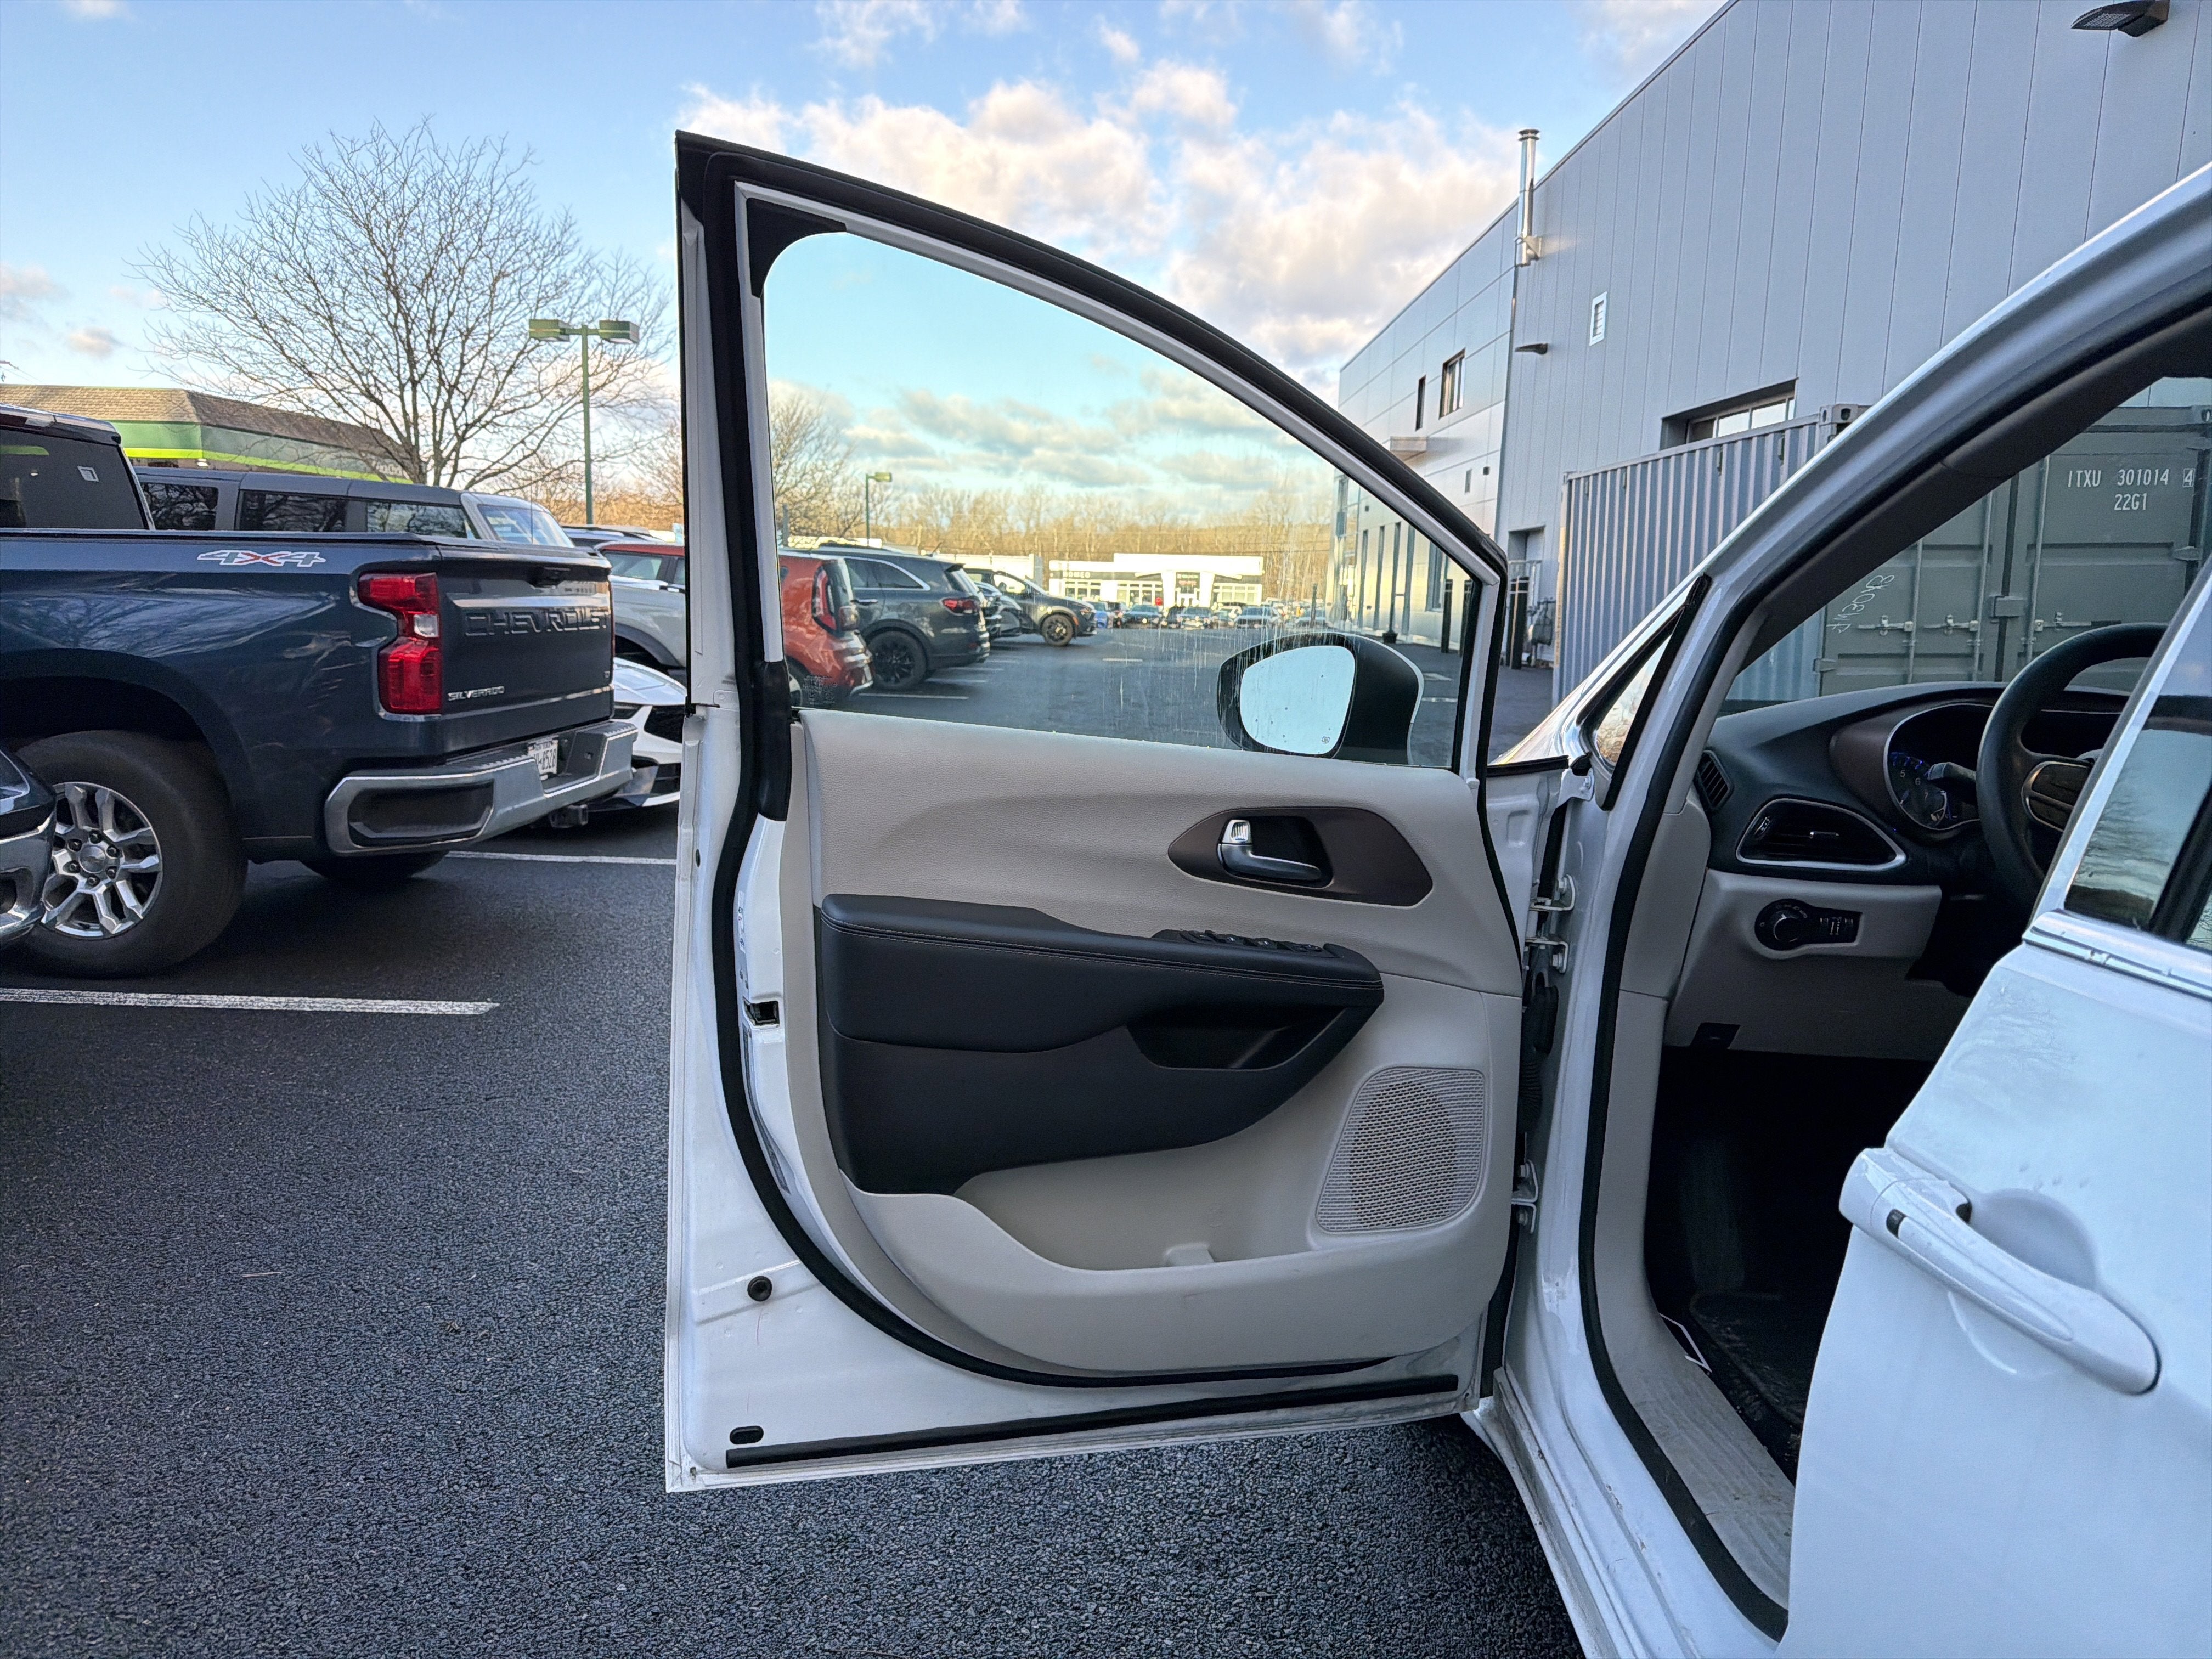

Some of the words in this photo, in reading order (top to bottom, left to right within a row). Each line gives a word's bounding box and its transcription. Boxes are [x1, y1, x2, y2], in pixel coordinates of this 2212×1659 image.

[2068, 470, 2101, 487] ITXU
[2117, 469, 2169, 486] 301014
[2183, 469, 2194, 487] 4
[2114, 493, 2147, 511] 22G1
[465, 608, 609, 636] CHEVROLET
[448, 686, 505, 701] SILVERADO
[1900, 769, 1905, 777] 5
[1915, 777, 1921, 786] 6
